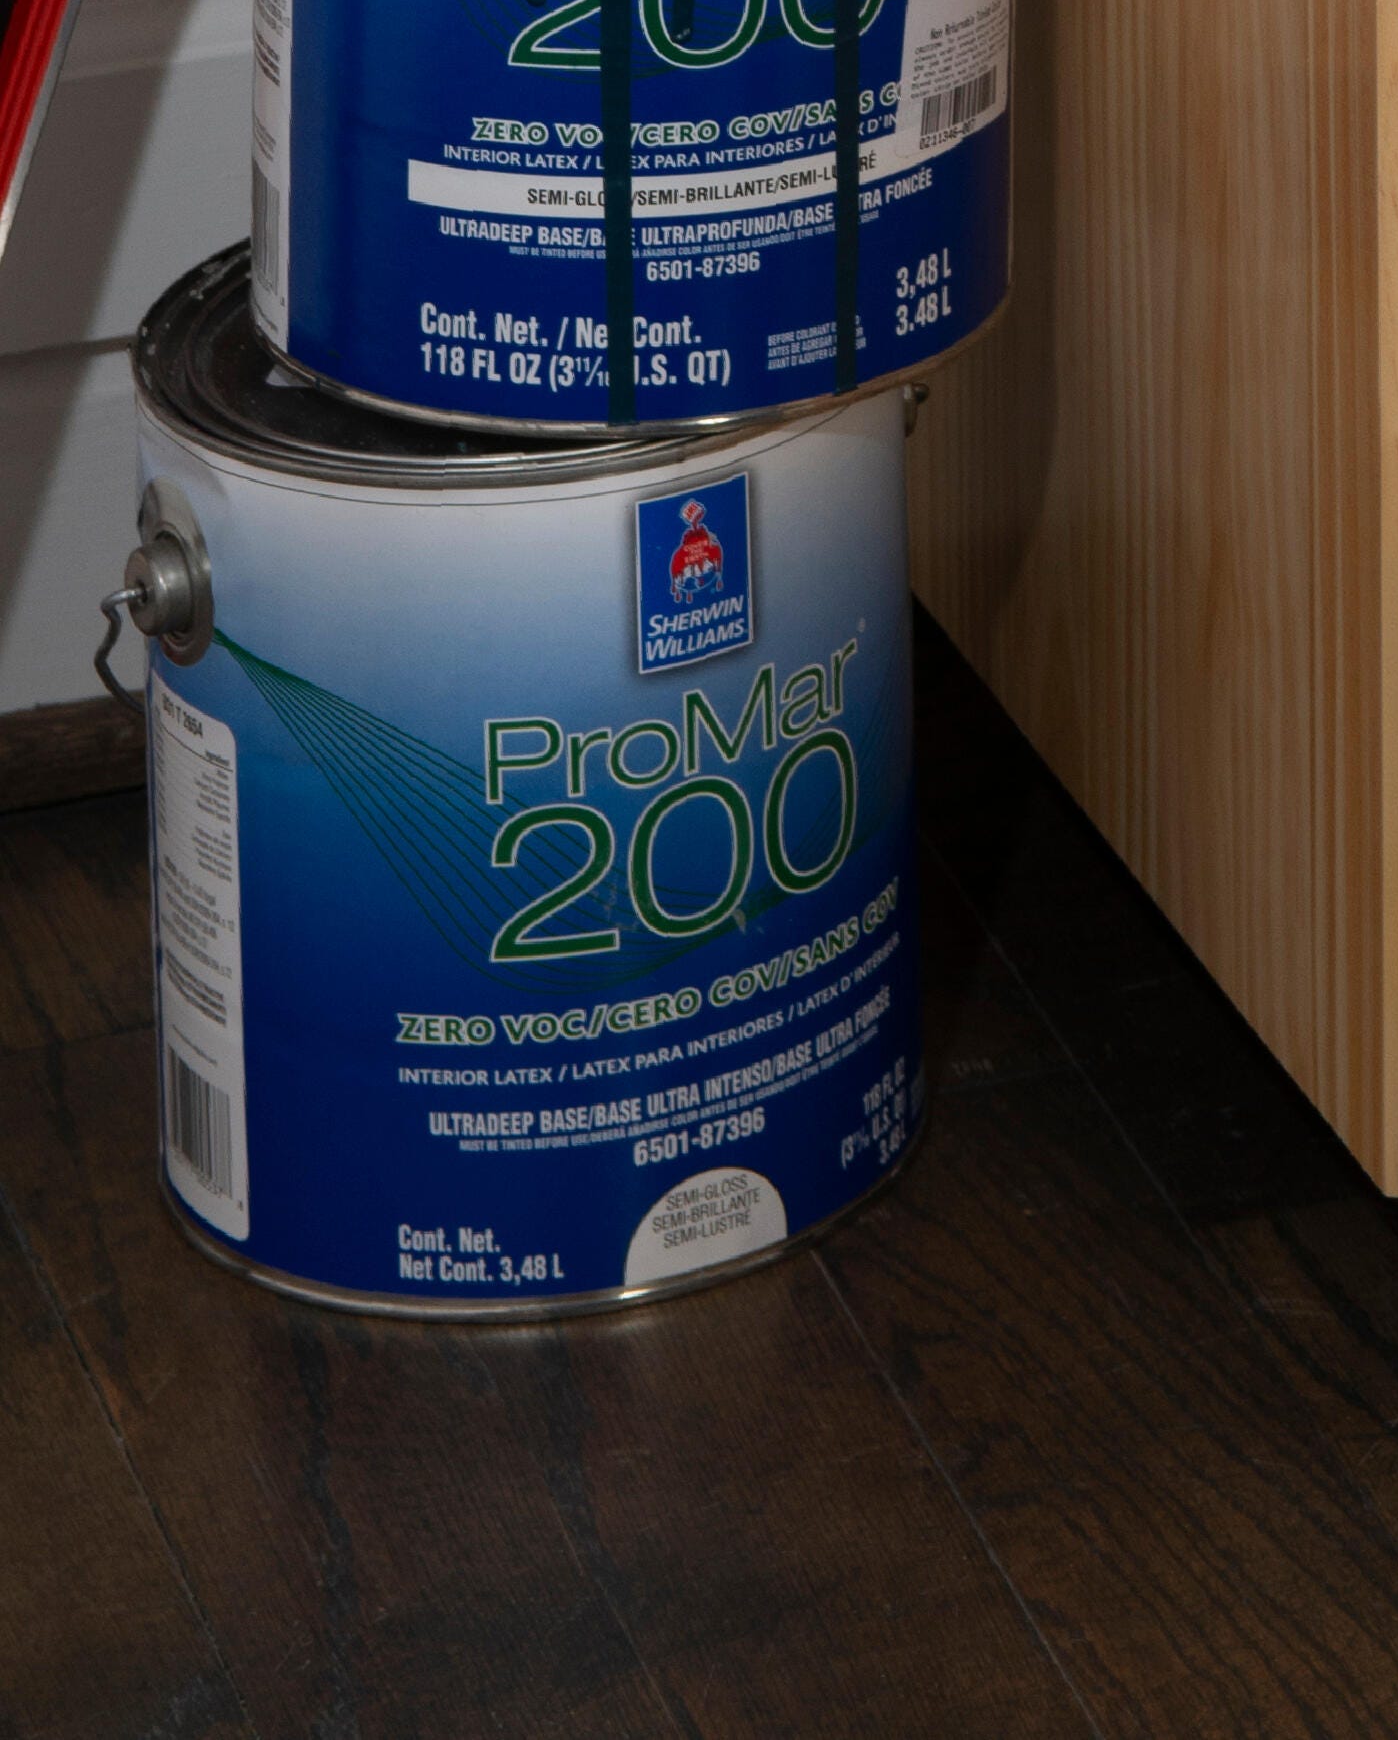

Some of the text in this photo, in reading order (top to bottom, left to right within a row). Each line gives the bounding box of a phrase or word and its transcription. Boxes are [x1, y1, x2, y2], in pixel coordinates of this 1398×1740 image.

[471, 117, 549, 146] ZERO
[555, 119, 719, 148] VO/CERO
[729, 90, 875, 139] COV/SAS
[444, 137, 804, 170] INTERIOR LATEX PARA INTERIORES
[440, 215, 533, 246] ULTRADEEP
[641, 202, 834, 246] ULTRAPROFUNDA/BASE
[885, 168, 933, 202] FONCÉE
[646, 251, 761, 282] 6501-87396
[896, 247, 952, 298] 3,48 L
[420, 301, 702, 351] Cont. Net. / Cont.
[895, 292, 938, 336] 3.48
[942, 286, 952, 316] L
[420, 342, 731, 387] 118 FL OZ QT)
[645, 618, 745, 662] WILLIAMS
[647, 595, 744, 638] SHERWIN
[484, 639, 858, 805] ProMar
[490, 727, 858, 963] 200
[396, 876, 899, 1046] ZERO VOC/CERO COV/SANS COV
[399, 986, 839, 1085] INTERIOR LATEX LATEX PARA INTERIORES LATEX
[429, 1111, 533, 1137] ULTRADEEP
[539, 1101, 643, 1135] BASE/BASE
[646, 1086, 700, 1117] ULTRA
[705, 1040, 813, 1101] INTENSO/BASE
[816, 1017, 853, 1058] ULTRA
[633, 1106, 766, 1168] 6501-87396
[652, 1190, 760, 1234] SEMI-BRILLANTE
[666, 1173, 750, 1211] SEMI-GLOSS
[398, 1224, 501, 1253] Cont. Net.
[664, 1209, 752, 1249] SEMI-LUSTRÉ
[399, 1253, 565, 1286] Net Cont. 3,48 L
